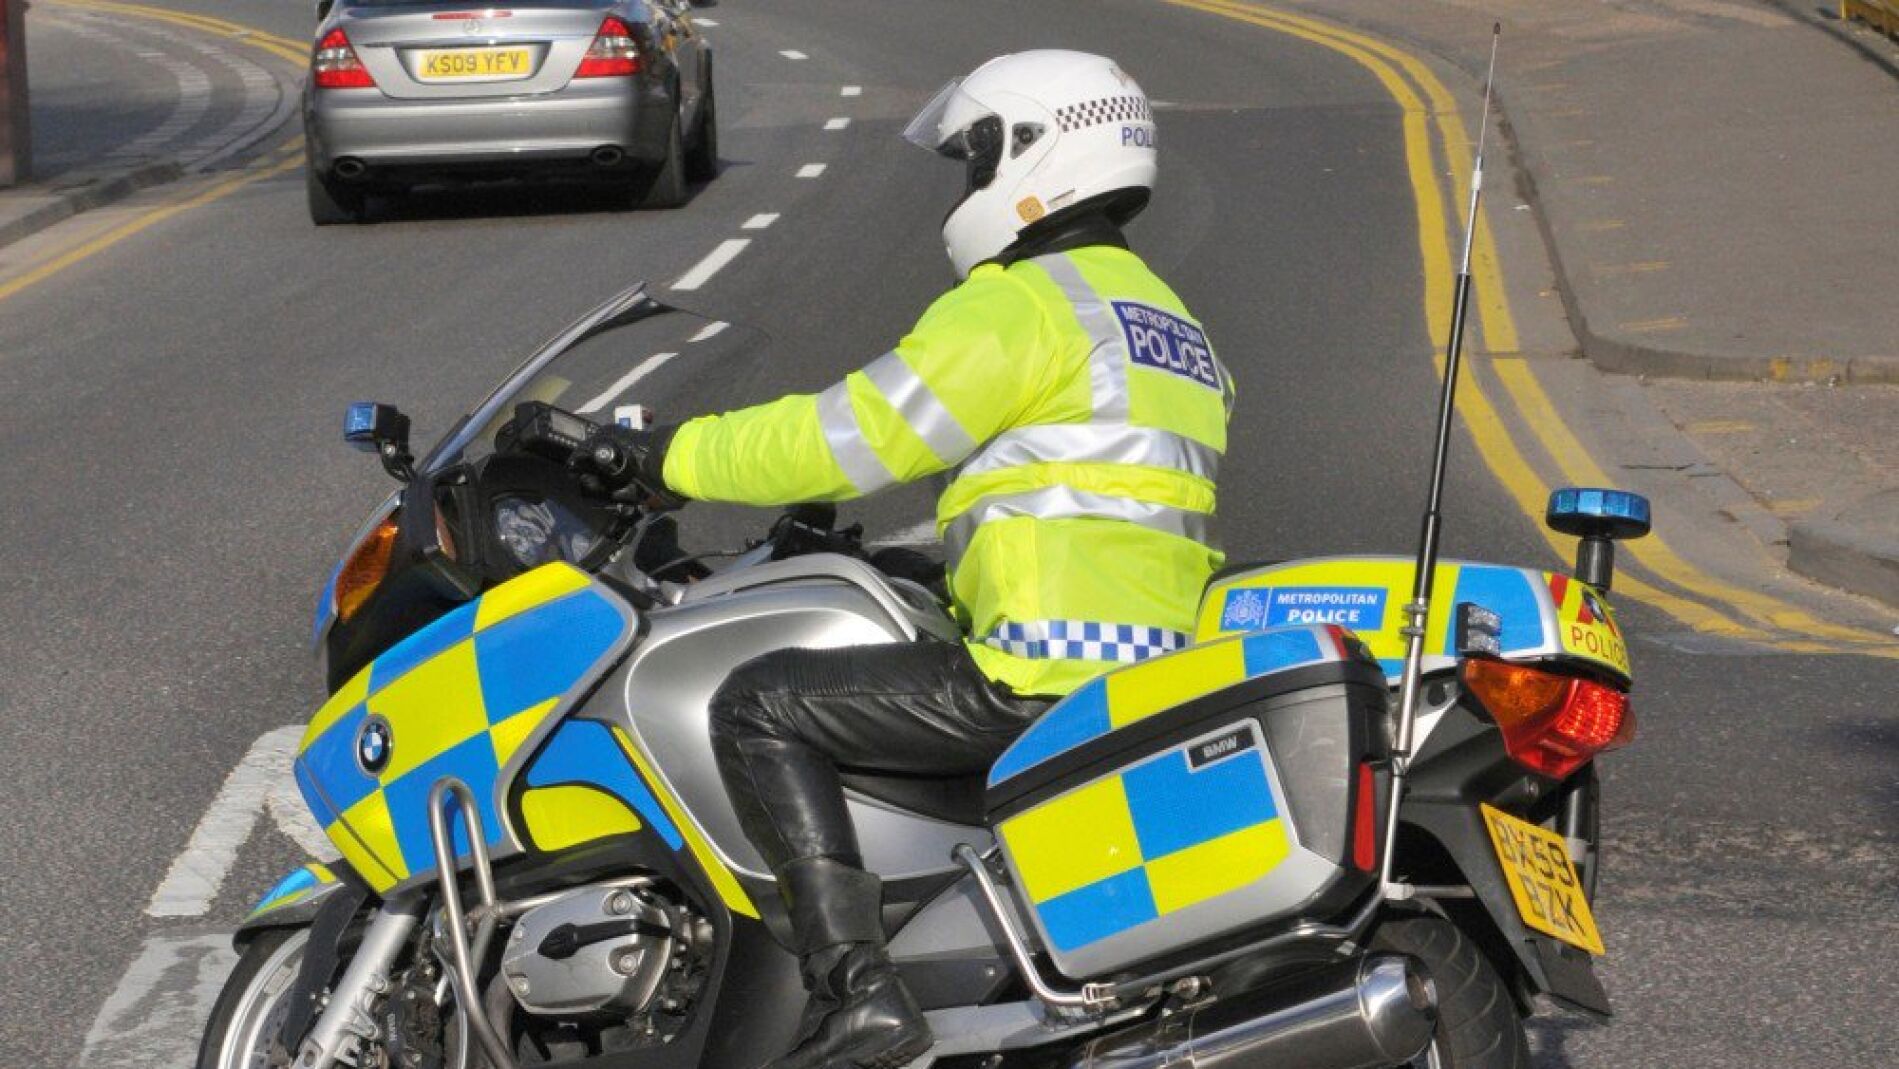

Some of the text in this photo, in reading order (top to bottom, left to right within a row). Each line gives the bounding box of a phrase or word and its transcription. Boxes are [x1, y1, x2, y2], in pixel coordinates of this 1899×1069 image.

[426, 54, 477, 73] KS09
[1130, 324, 1215, 382] POLICE
[1277, 593, 1378, 605] METROPOLITAN
[1287, 609, 1360, 623] POLICE
[1203, 735, 1237, 758] BMW
